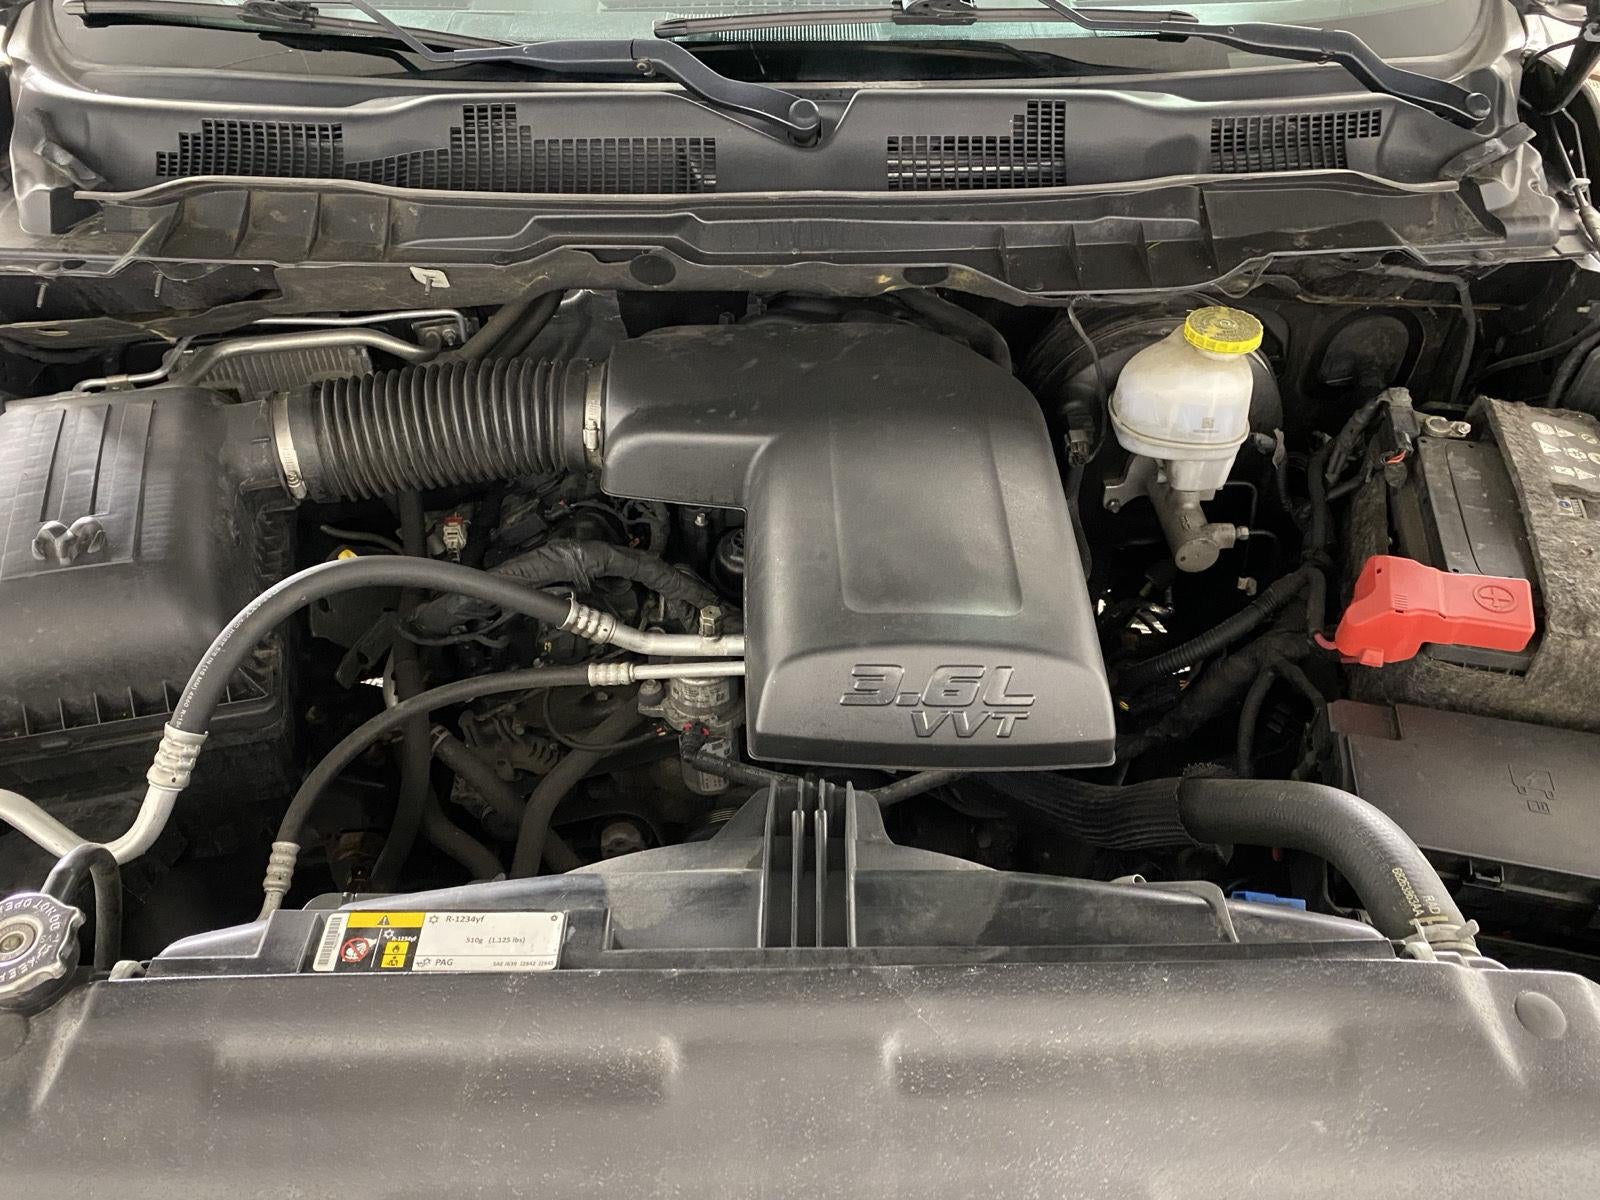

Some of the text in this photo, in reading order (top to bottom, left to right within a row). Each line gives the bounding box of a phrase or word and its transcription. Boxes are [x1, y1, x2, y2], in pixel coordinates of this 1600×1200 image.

[220, 628, 235, 647] HOSE
[839, 663, 1036, 707] 3.6L
[910, 710, 1030, 738] VVT
[33, 899, 57, 917] NOT
[1423, 895, 1441, 914] RAD
[445, 914, 485, 924] R-1234yf
[465, 937, 484, 945] 510g
[434, 958, 454, 967] PAG
